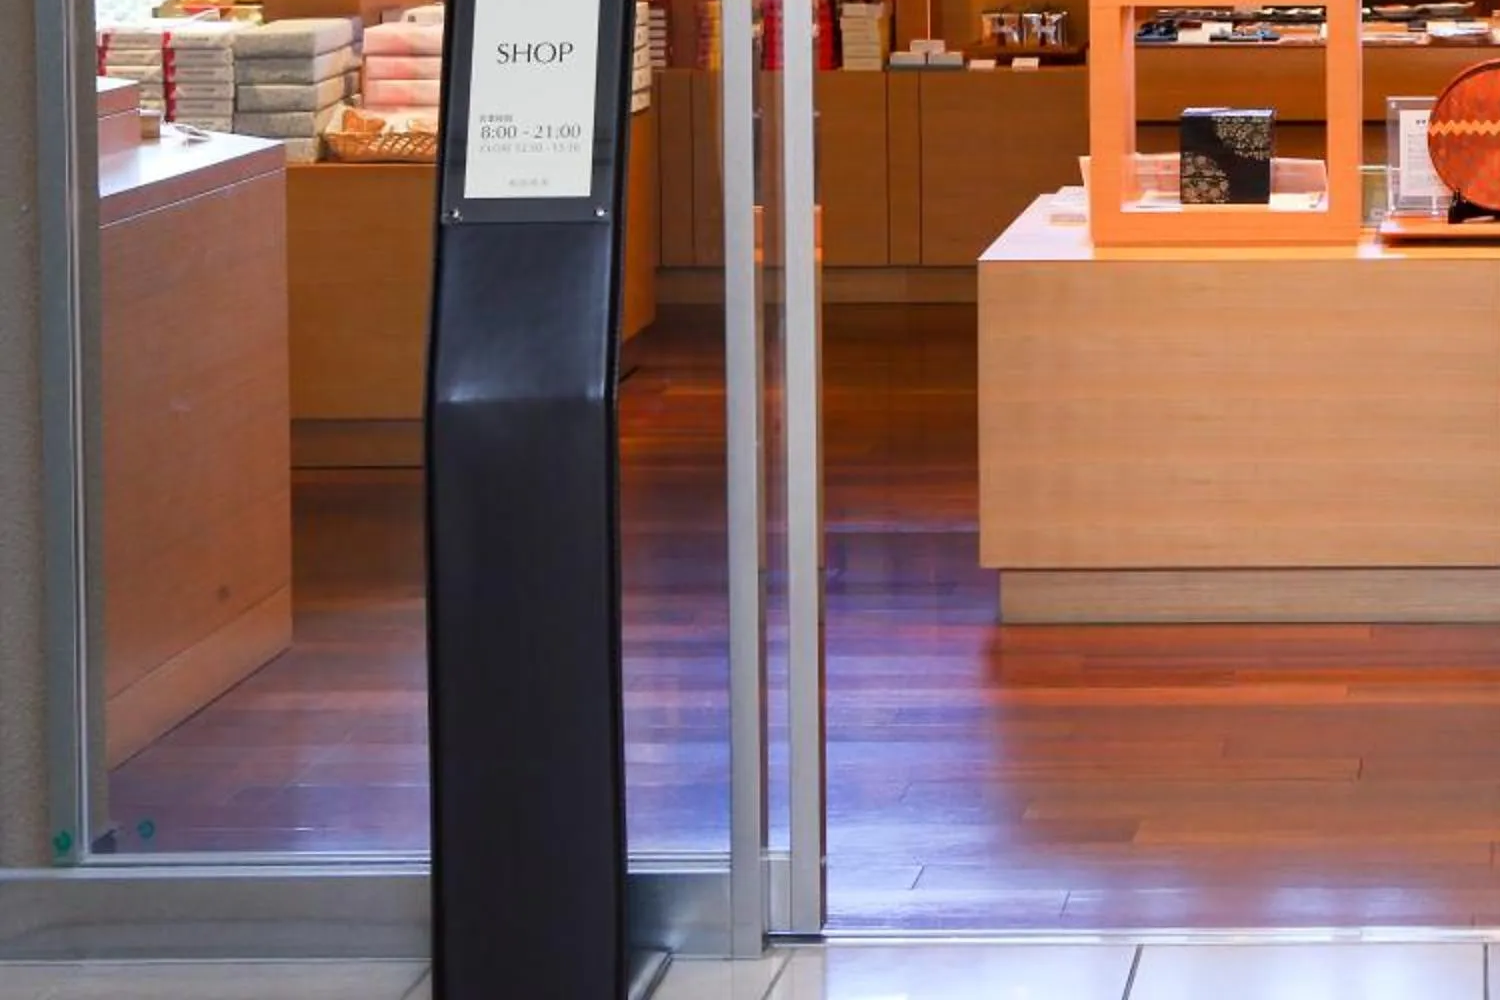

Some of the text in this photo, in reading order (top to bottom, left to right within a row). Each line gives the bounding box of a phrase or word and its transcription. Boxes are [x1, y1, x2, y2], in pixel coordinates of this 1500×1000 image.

[496, 41, 574, 65] SHOP
[480, 125, 517, 140] 8:00
[533, 123, 581, 140] 21:00
